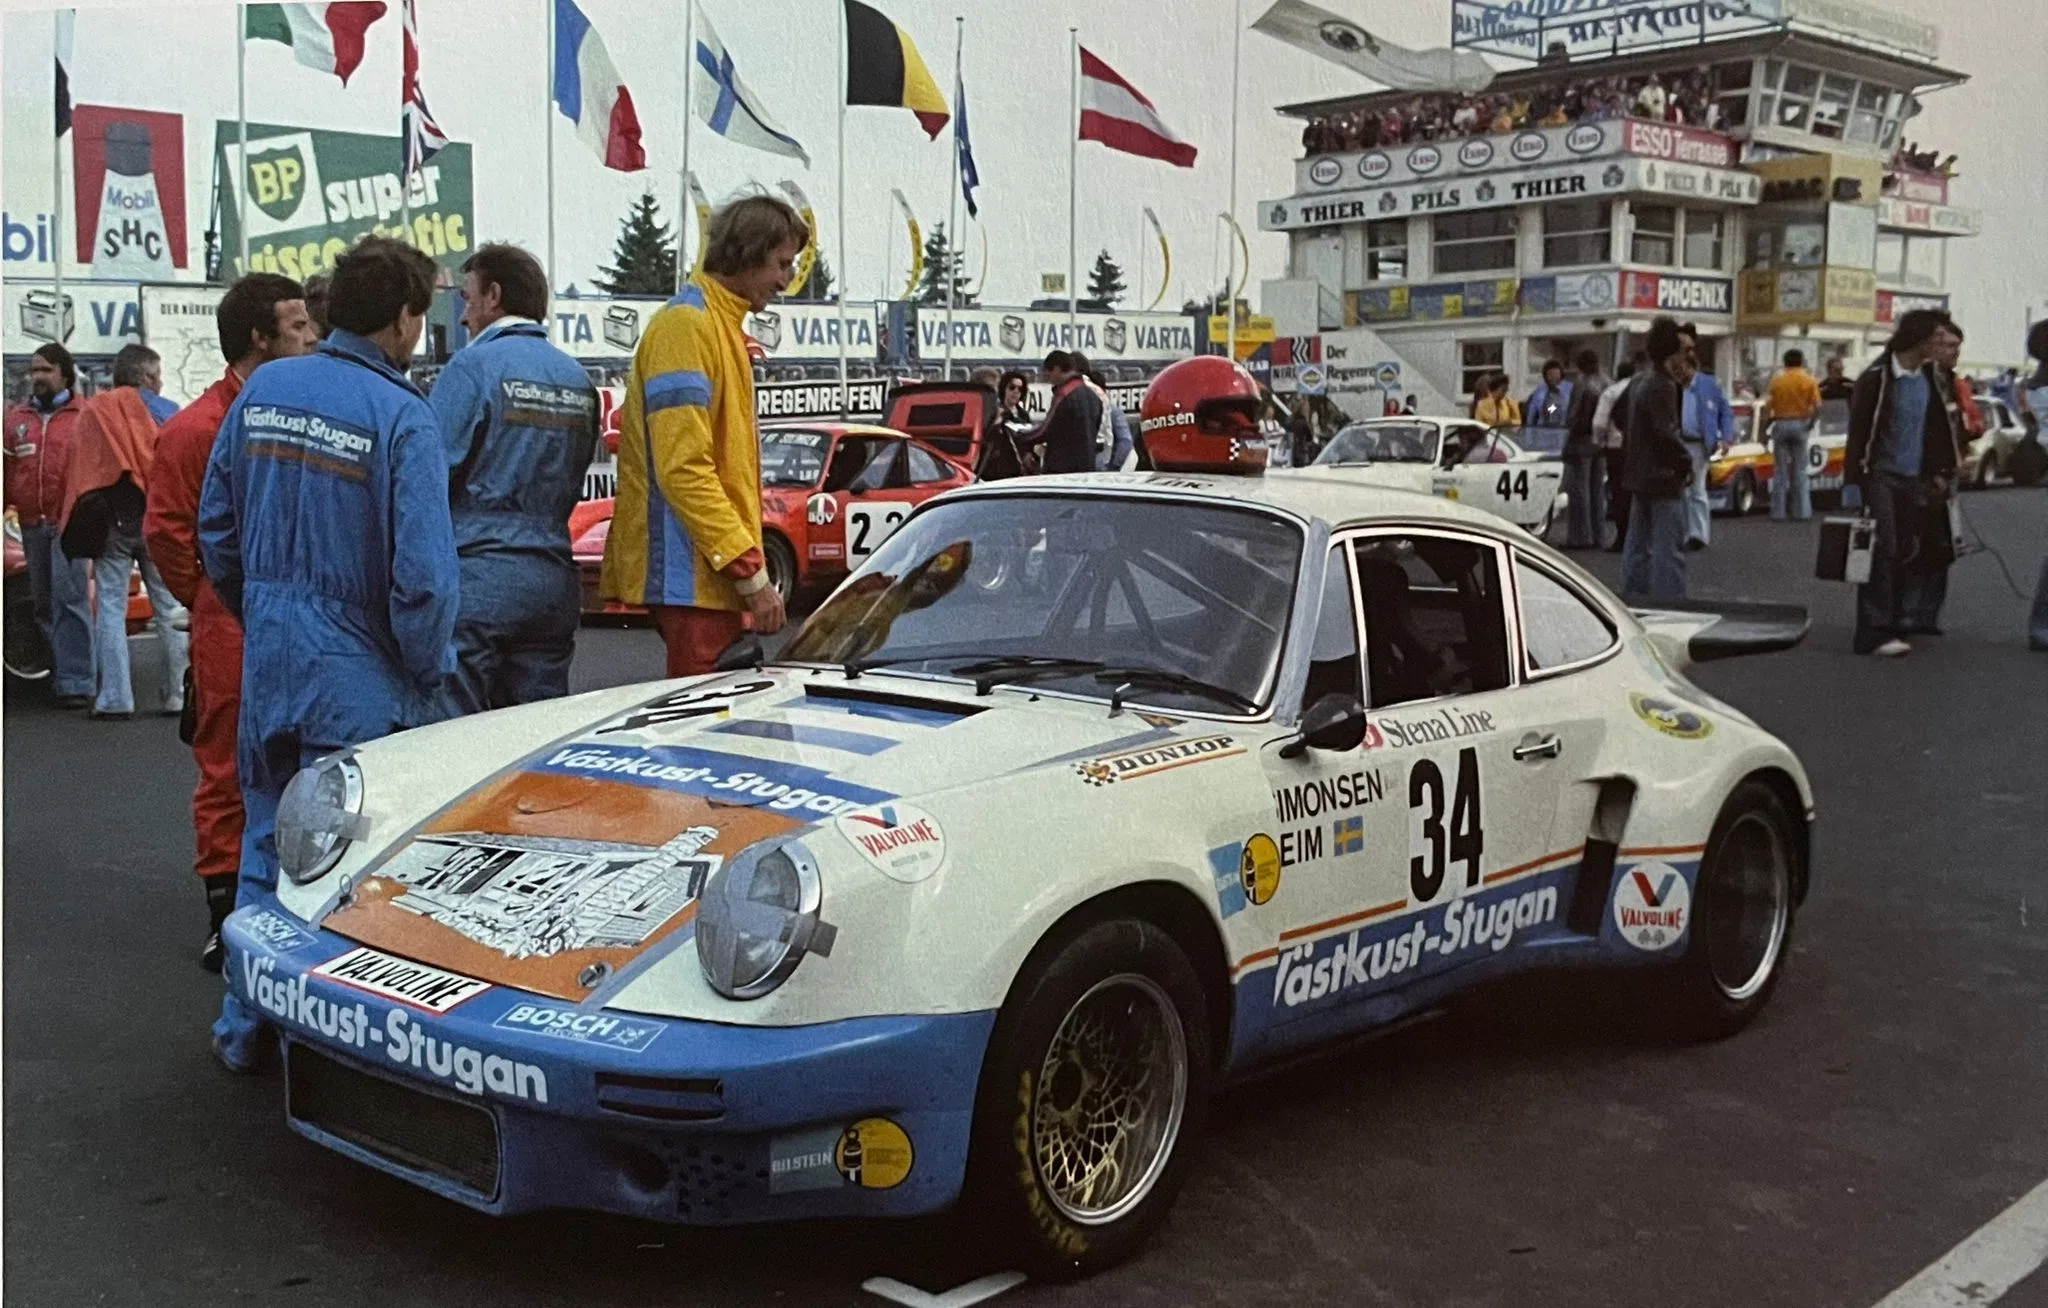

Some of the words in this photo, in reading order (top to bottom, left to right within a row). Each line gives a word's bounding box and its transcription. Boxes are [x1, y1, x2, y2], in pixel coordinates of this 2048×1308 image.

[1631, 123, 1672, 158] ESSO
[107, 187, 154, 209] Mobil
[250, 157, 300, 204] BP
[326, 165, 440, 223] super
[1301, 201, 1366, 223] THIER
[1411, 190, 1460, 211] PILS
[1512, 175, 1586, 200] THIER
[104, 219, 162, 260] SHC
[1658, 279, 1728, 309] PHOENIX
[792, 317, 872, 346] VARTA
[922, 321, 992, 347] VARTA
[1033, 322, 1097, 348] VARTA
[1134, 325, 1192, 350] VARTA
[758, 380, 884, 416] REGENREFEN
[1140, 411, 1196, 433] monsen
[1496, 469, 1529, 501] 44
[1378, 717, 1450, 748] Stena
[1440, 707, 1496, 737] Line
[1112, 736, 1235, 773] DUNLOP
[1273, 768, 1382, 823] IMONSEN
[856, 818, 939, 858] VALVOLINE
[1409, 747, 1484, 902] 34
[1619, 905, 1684, 931] VALVOLINE
[330, 951, 477, 1008] VALVOLINE
[243, 952, 547, 1104] Västkust-Stugan
[507, 1006, 620, 1036] BOSCH
[772, 1151, 833, 1173] BILSTEIN
